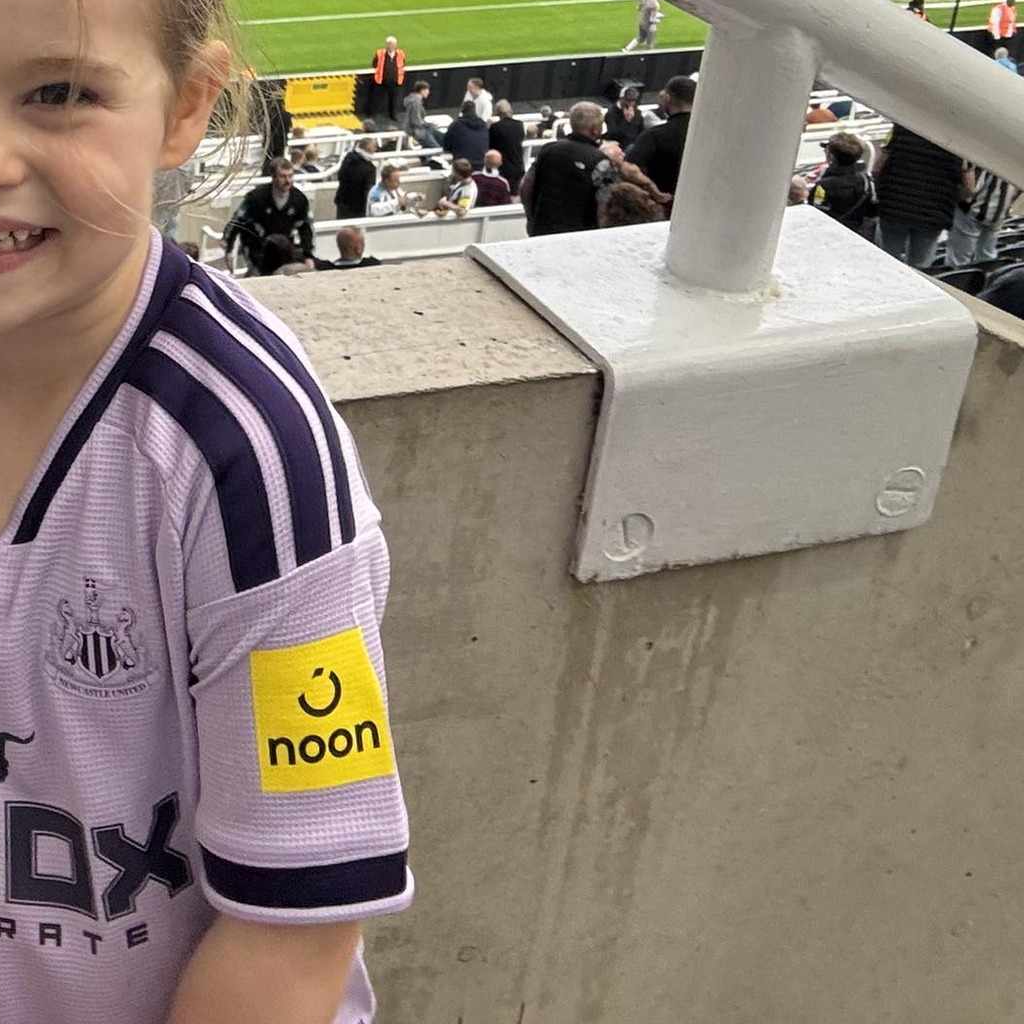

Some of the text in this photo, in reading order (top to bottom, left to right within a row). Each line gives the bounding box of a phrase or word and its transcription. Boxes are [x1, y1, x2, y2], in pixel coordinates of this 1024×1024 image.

[59, 677, 147, 697] NEWCASTLE UNITED
[268, 720, 381, 766] noon
